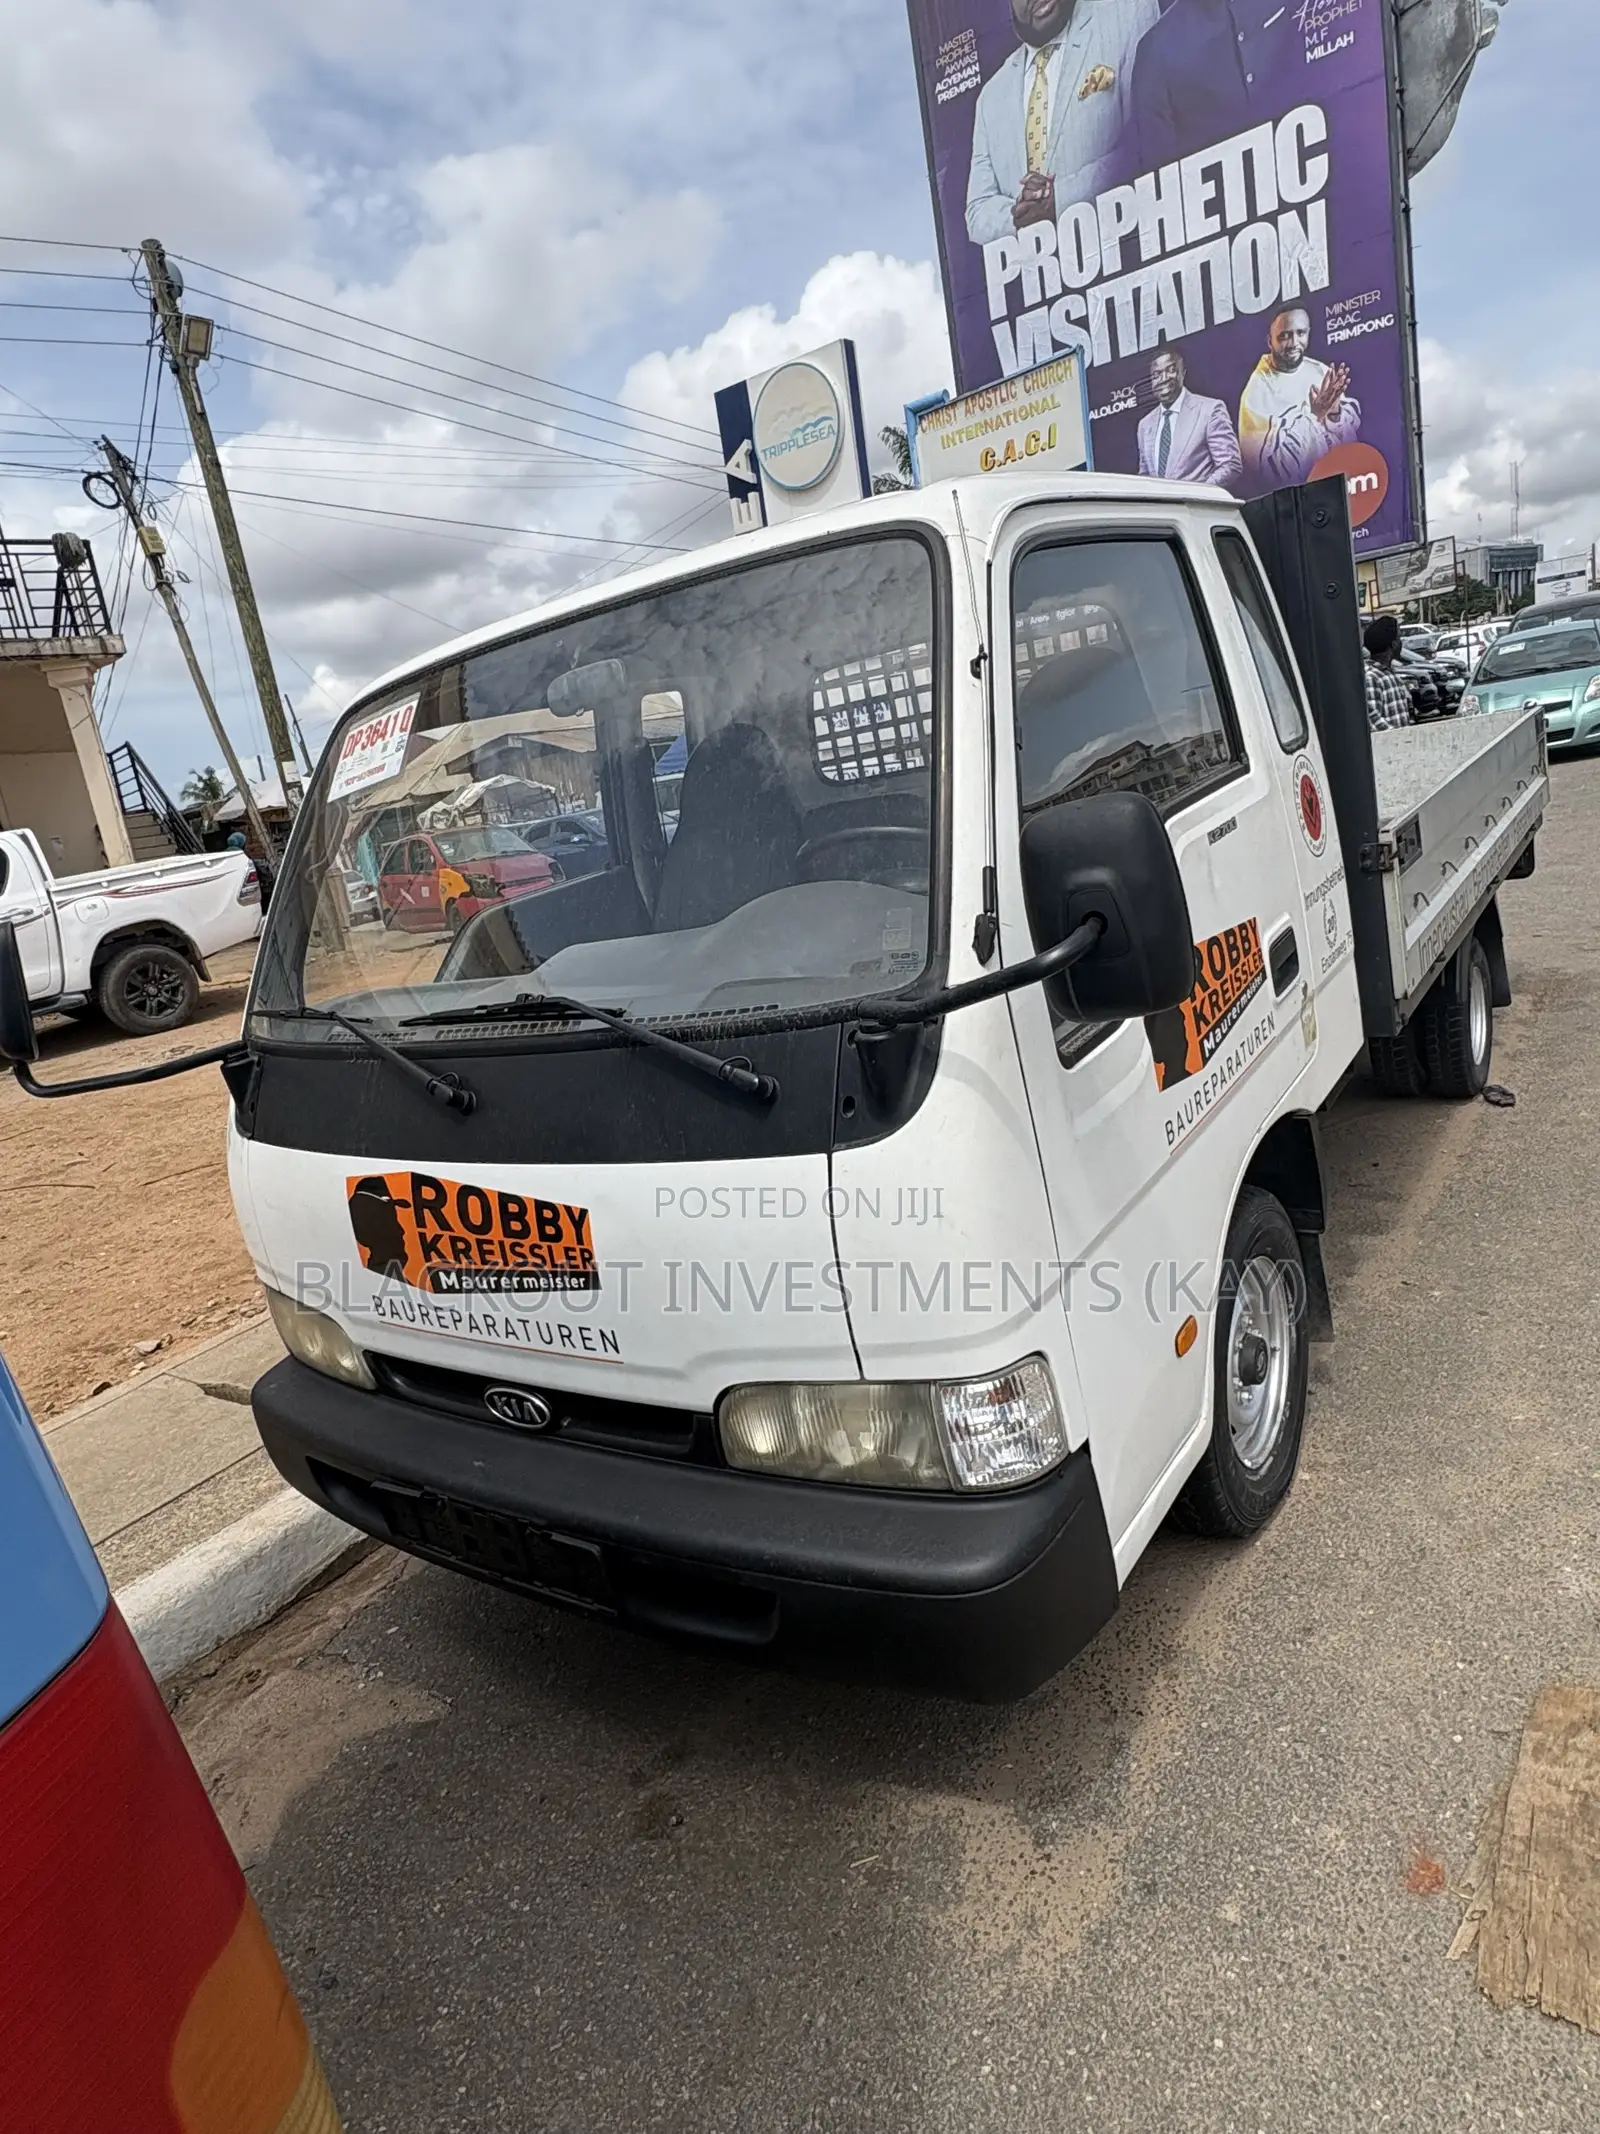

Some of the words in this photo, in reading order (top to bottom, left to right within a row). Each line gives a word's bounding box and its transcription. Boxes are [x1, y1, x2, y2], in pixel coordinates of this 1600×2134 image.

[936, 39, 977, 68] PROPHET
[939, 29, 974, 55] MASTER
[1306, 31, 1354, 63] MILLAH
[935, 62, 980, 94] AGYEMAN
[944, 51, 978, 76] AKWASI
[937, 74, 981, 105] PREMPEH
[982, 104, 1329, 321] PROPHETIC
[990, 199, 1330, 377] VISITATION
[1325, 290, 1381, 318] MINISTER
[1326, 311, 1361, 331] ISAAC
[1327, 314, 1394, 345] FRIMPONG
[920, 405, 959, 434] CHRIST
[964, 382, 1019, 418] APOSTLIC
[1023, 358, 1074, 395] CHURCH
[1089, 397, 1138, 420] ALOLOME
[1110, 386, 1137, 401] JACK
[940, 394, 1061, 450] INTERNATIONAL
[761, 424, 837, 461] TRIPPLESEA
[1207, 817, 1237, 846] K2700
[1193, 917, 1260, 998] ROBBY
[1191, 951, 1265, 1038] KREISSLER
[1203, 973, 1265, 1058] Maurermeister
[1165, 1011, 1276, 1147] BAUREPARATUREN
[411, 1172, 589, 1246] ROBBY
[418, 1232, 595, 1271] KREISSLER
[439, 1271, 587, 1290] Maurermeister
[372, 1295, 621, 1355] BAUREPARATUREN
[493, 1395, 541, 1423] KIA
